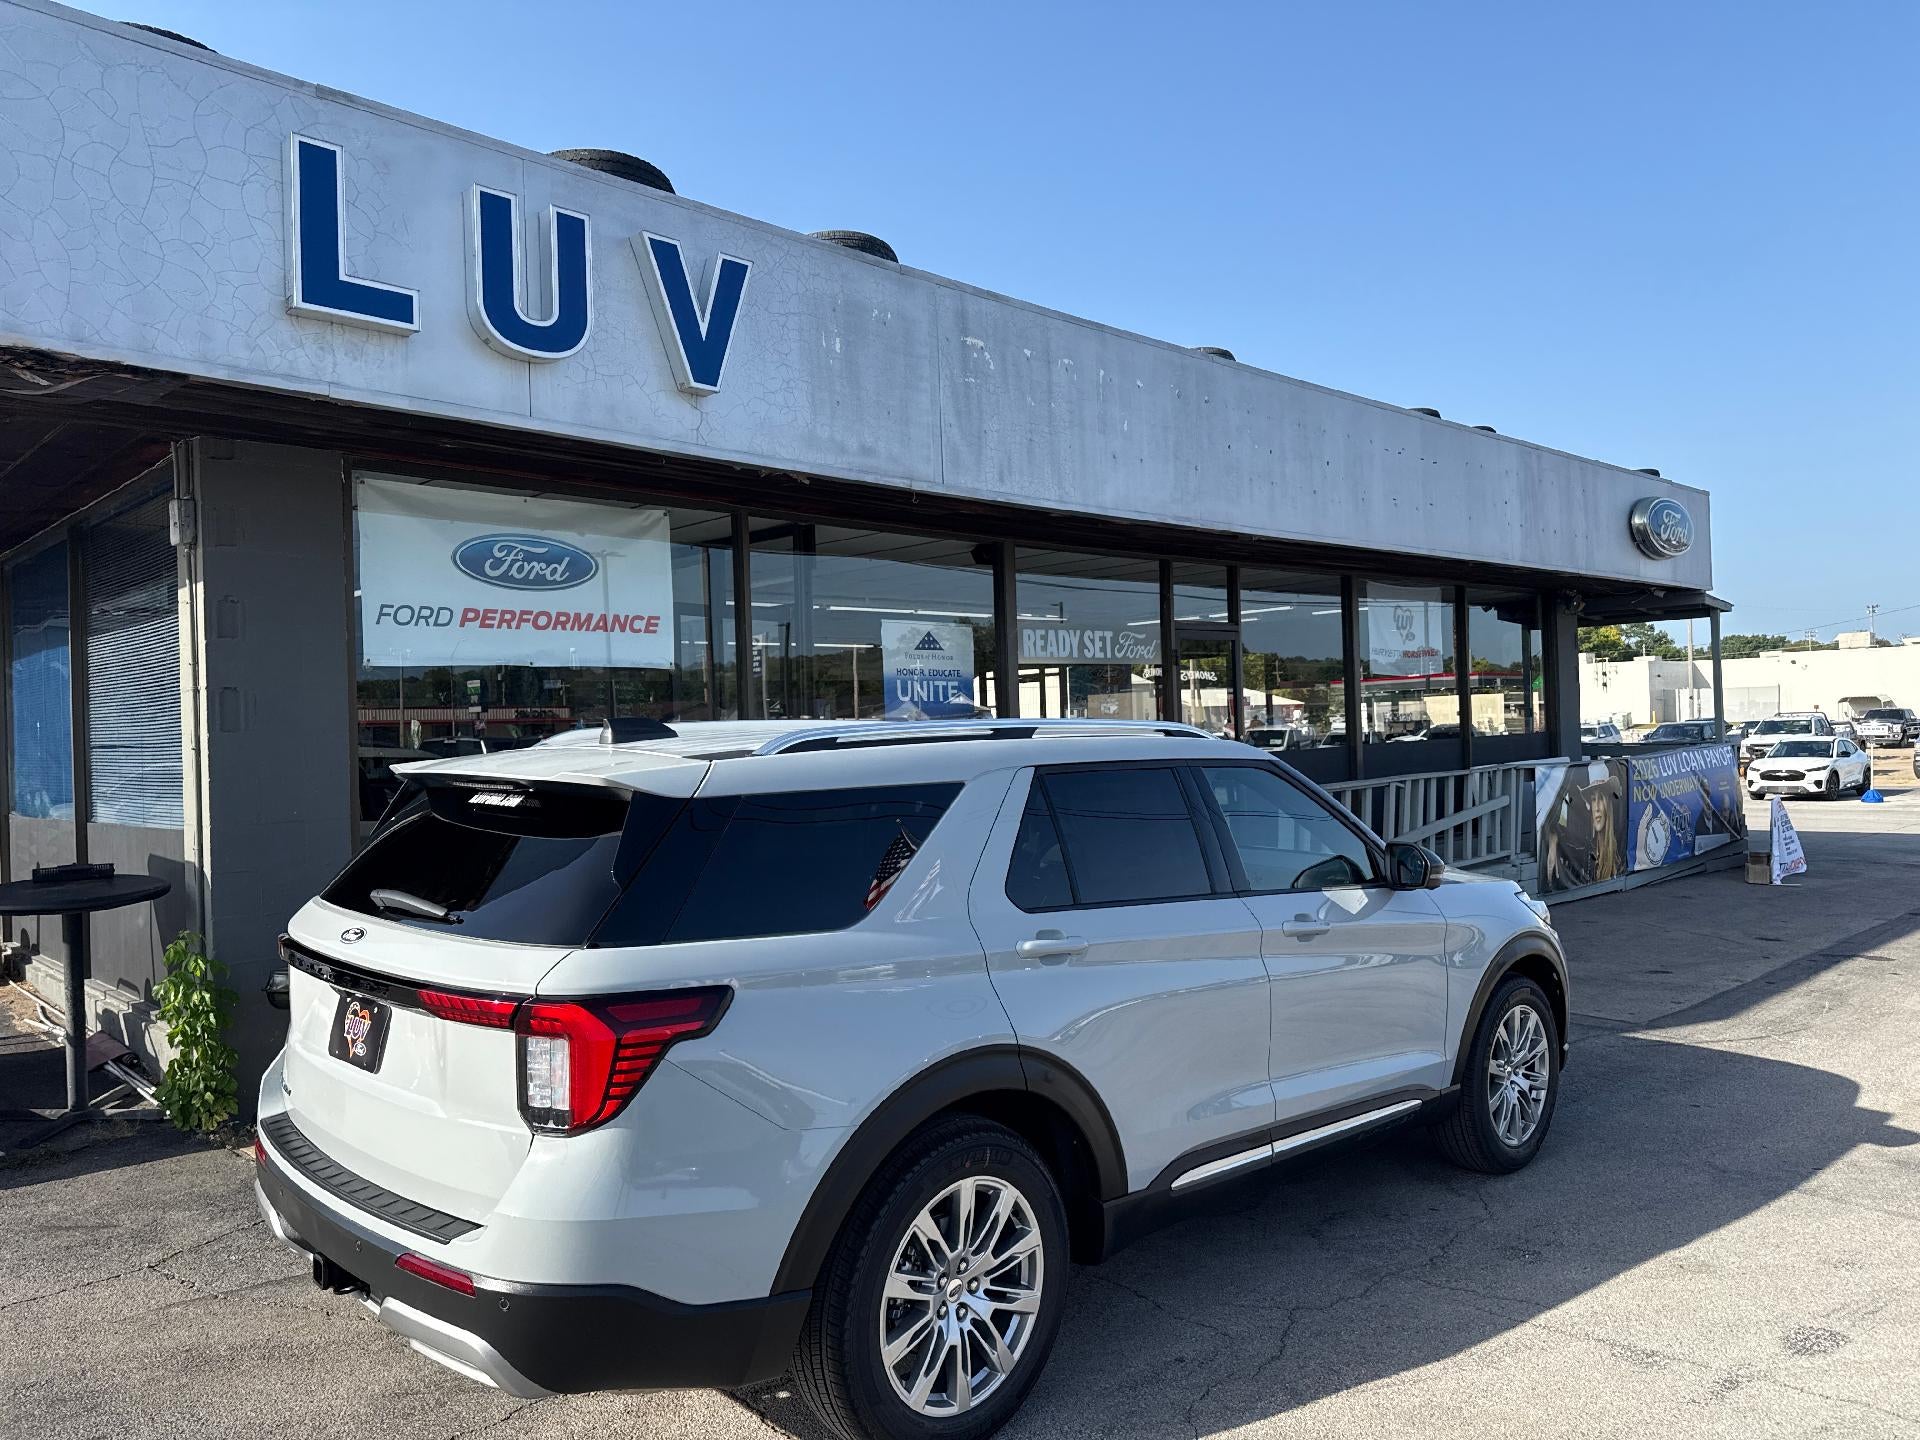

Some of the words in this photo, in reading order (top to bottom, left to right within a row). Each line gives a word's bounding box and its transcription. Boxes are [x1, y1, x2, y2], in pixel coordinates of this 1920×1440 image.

[287, 132, 754, 395] LUV
[1660, 509, 1690, 543] Ford
[484, 542, 570, 582] Ford
[375, 603, 454, 628] FORD
[458, 607, 661, 634] PERFORMANCE
[1022, 628, 1082, 659] READY
[1083, 630, 1113, 659] SET
[1115, 631, 1157, 659] Ford
[1632, 759, 1660, 781] 2026
[1658, 754, 1678, 777] LUV
[1677, 749, 1705, 772] LOAN
[1633, 783, 1657, 802] NOW
[344, 1014, 371, 1040] LUV
